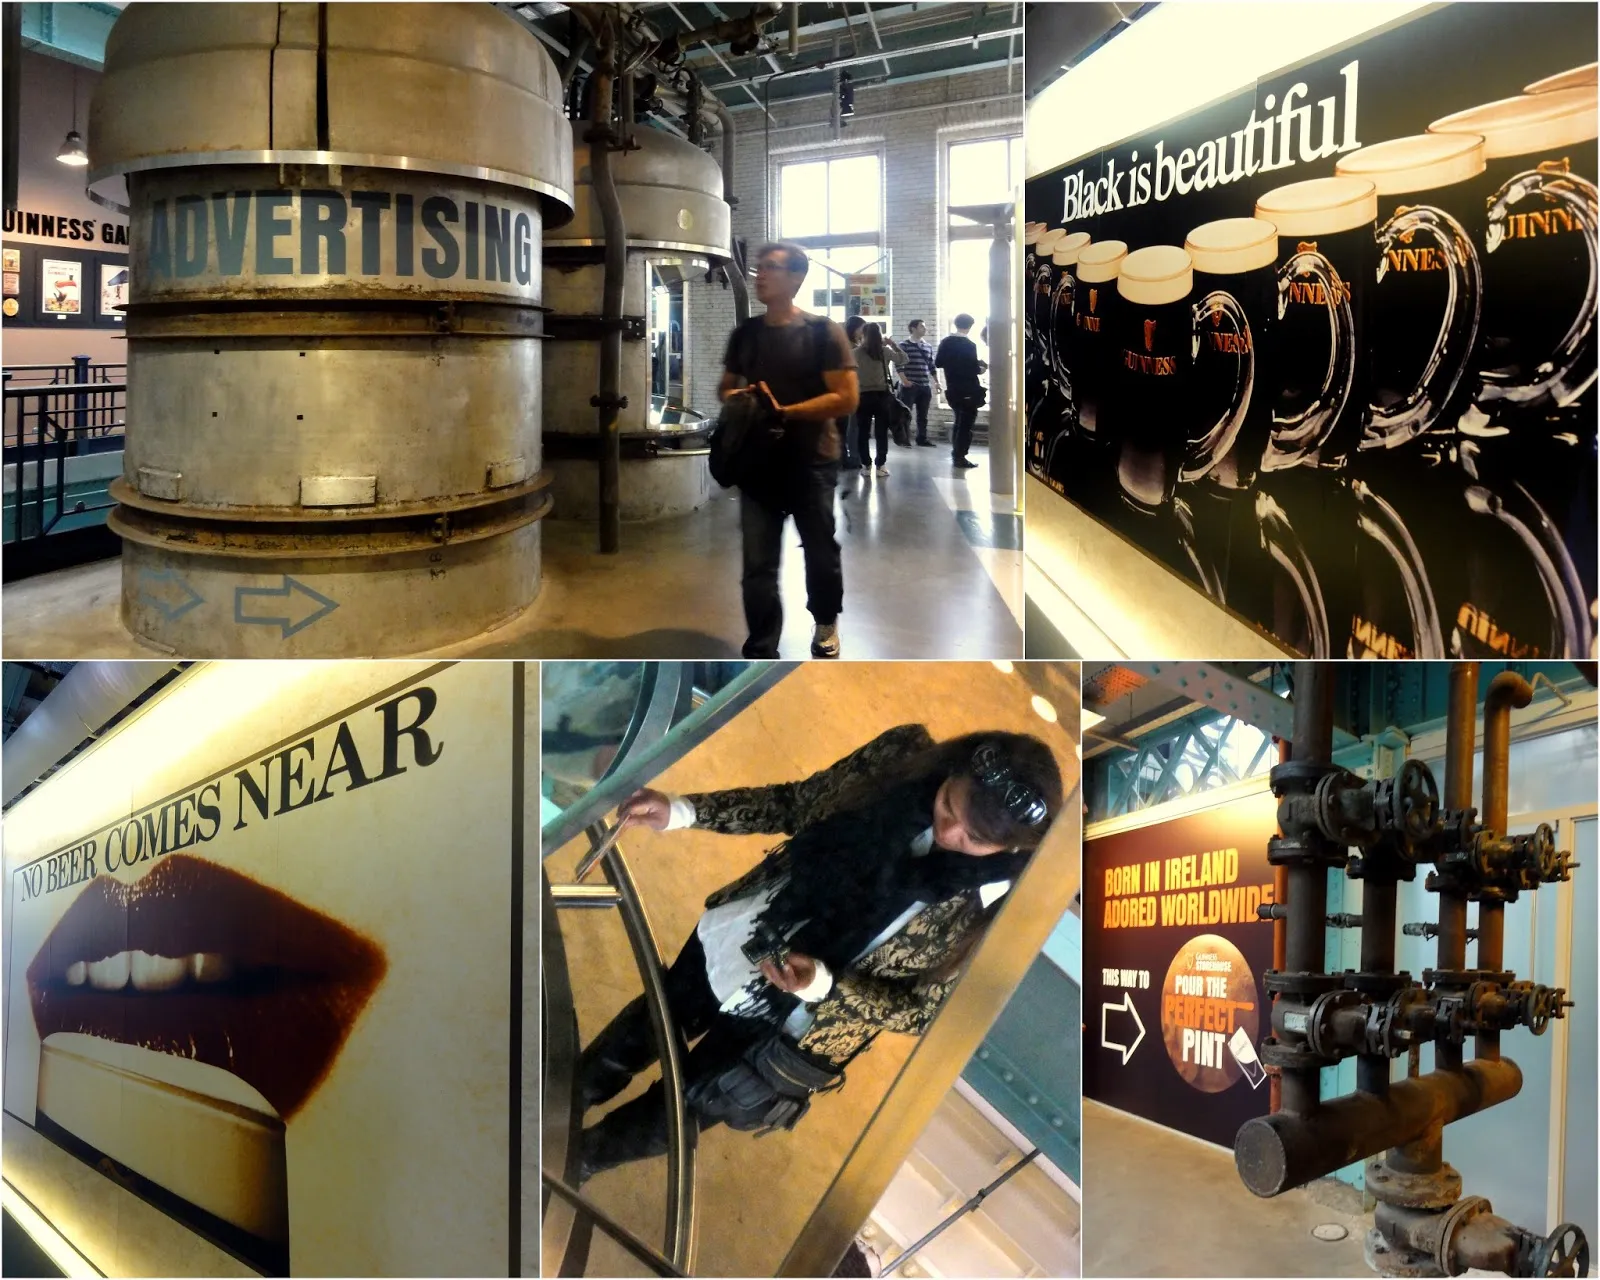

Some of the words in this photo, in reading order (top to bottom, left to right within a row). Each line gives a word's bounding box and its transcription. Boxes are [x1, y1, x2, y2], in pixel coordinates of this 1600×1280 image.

[1061, 159, 1124, 223] Black
[1127, 151, 1151, 208] is
[1155, 60, 1362, 202] beautiful
[146, 189, 532, 287] ADVERTISING
[21, 868, 43, 902] NO
[46, 840, 98, 894] BEER
[105, 781, 221, 872] COMES
[233, 686, 445, 831] NEAR
[1104, 864, 1141, 898] BORN
[1144, 861, 1161, 893] IN
[1165, 848, 1239, 891] IRELAND
[1103, 896, 1157, 928] ADORED
[1161, 884, 1275, 927] WORLDWIDE
[1102, 968, 1120, 987] THIS
[1120, 970, 1137, 989] WAY
[1137, 971, 1150, 990] TO
[1175, 975, 1204, 996] POUR
[1206, 976, 1227, 999] THE
[1164, 994, 1254, 1034] PERFECT
[1182, 1028, 1226, 1070] PINT
